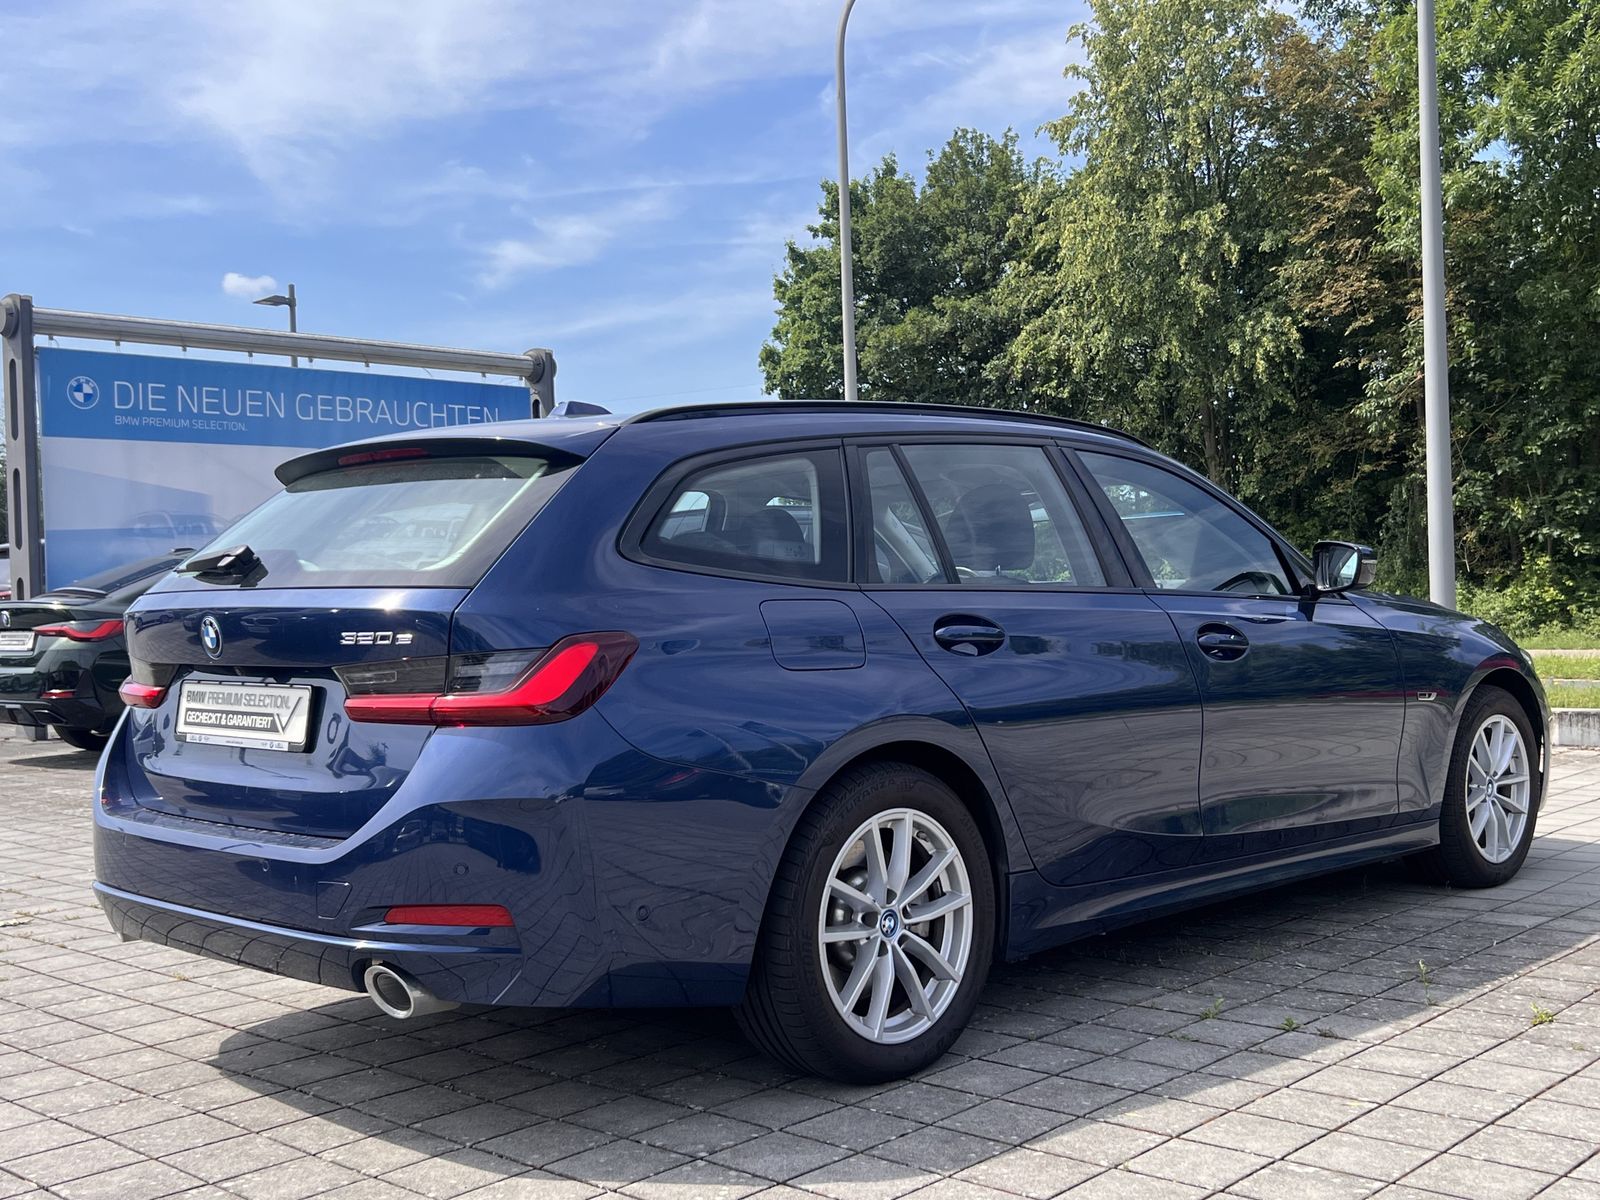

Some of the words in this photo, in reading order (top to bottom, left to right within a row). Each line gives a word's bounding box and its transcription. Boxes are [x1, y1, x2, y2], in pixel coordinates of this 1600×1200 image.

[114, 381, 166, 411] DIE
[178, 385, 284, 419] NEUEN
[295, 393, 499, 428] GEBRAUCHTEN
[115, 415, 140, 426] BMW
[142, 417, 190, 428] PREMIUM
[192, 420, 248, 431] SELECTION.
[186, 690, 206, 704] BMW
[207, 691, 243, 706] PREMIUM
[186, 711, 221, 725] GECHECKT
[221, 714, 227, 725] &
[227, 713, 274, 729] GARANTIERT
